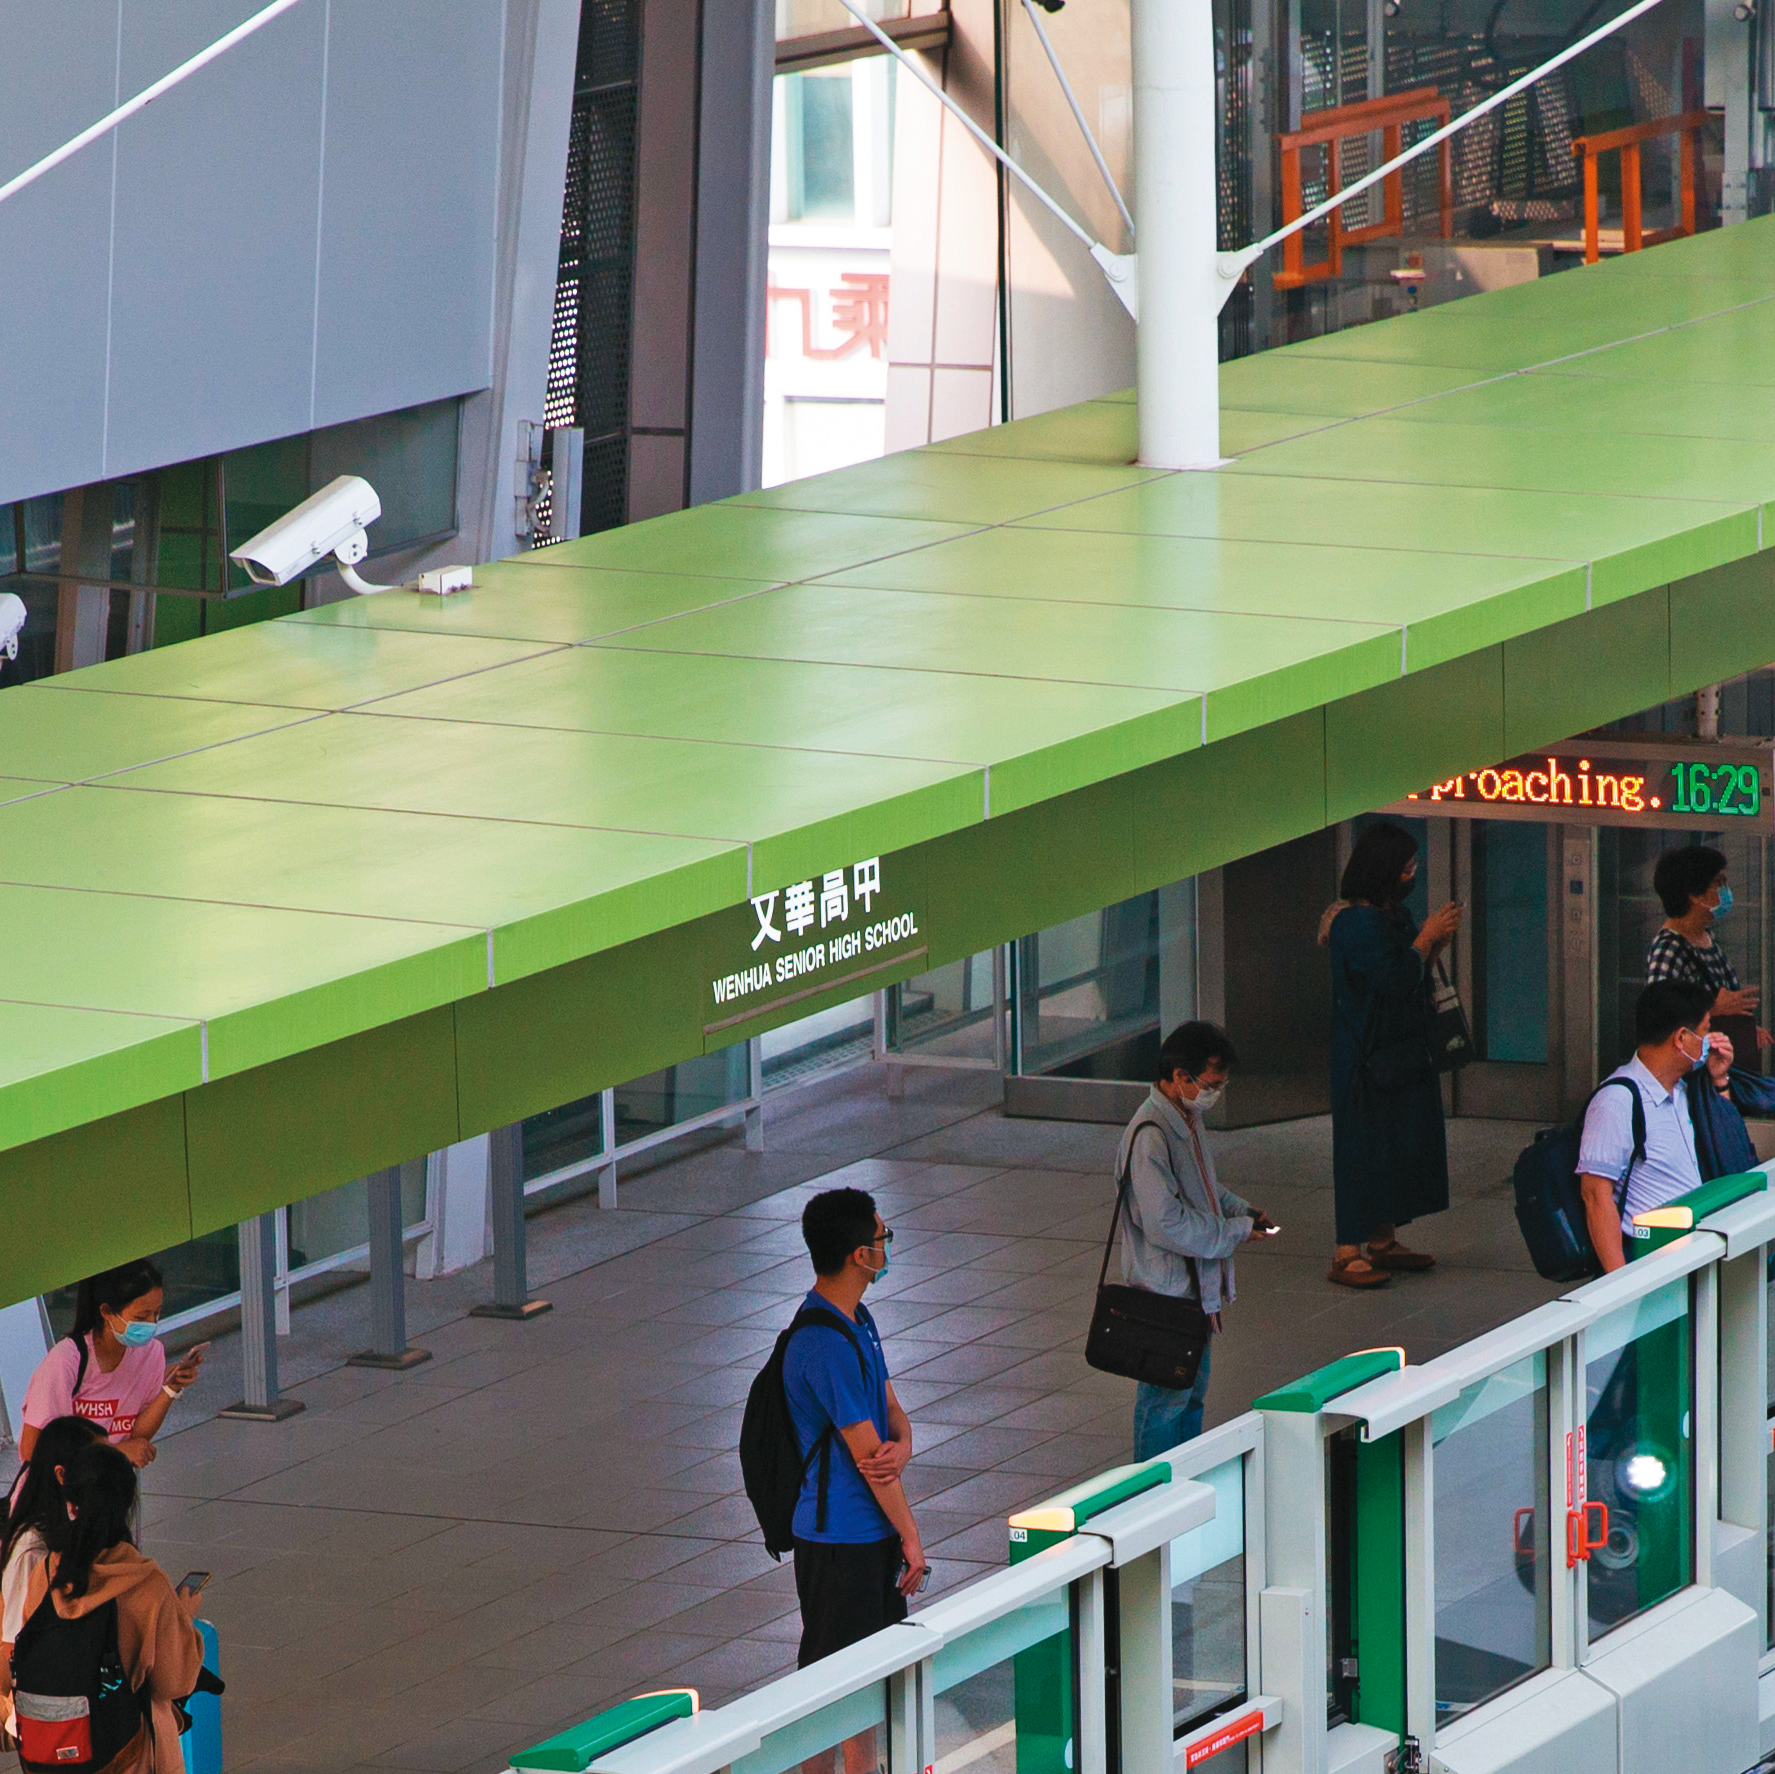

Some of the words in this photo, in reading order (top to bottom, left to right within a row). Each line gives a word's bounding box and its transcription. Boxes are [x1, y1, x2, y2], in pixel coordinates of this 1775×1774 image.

[1671, 762, 1761, 816] 16:29
[750, 856, 881, 952] 文華高中
[712, 962, 773, 1004] WENHUA
[775, 943, 826, 983] SENIOR
[828, 930, 862, 964] HIGH
[864, 911, 919, 951] SCHOOL
[74, 1401, 114, 1417] WHSH
[111, 1418, 136, 1433] MG
